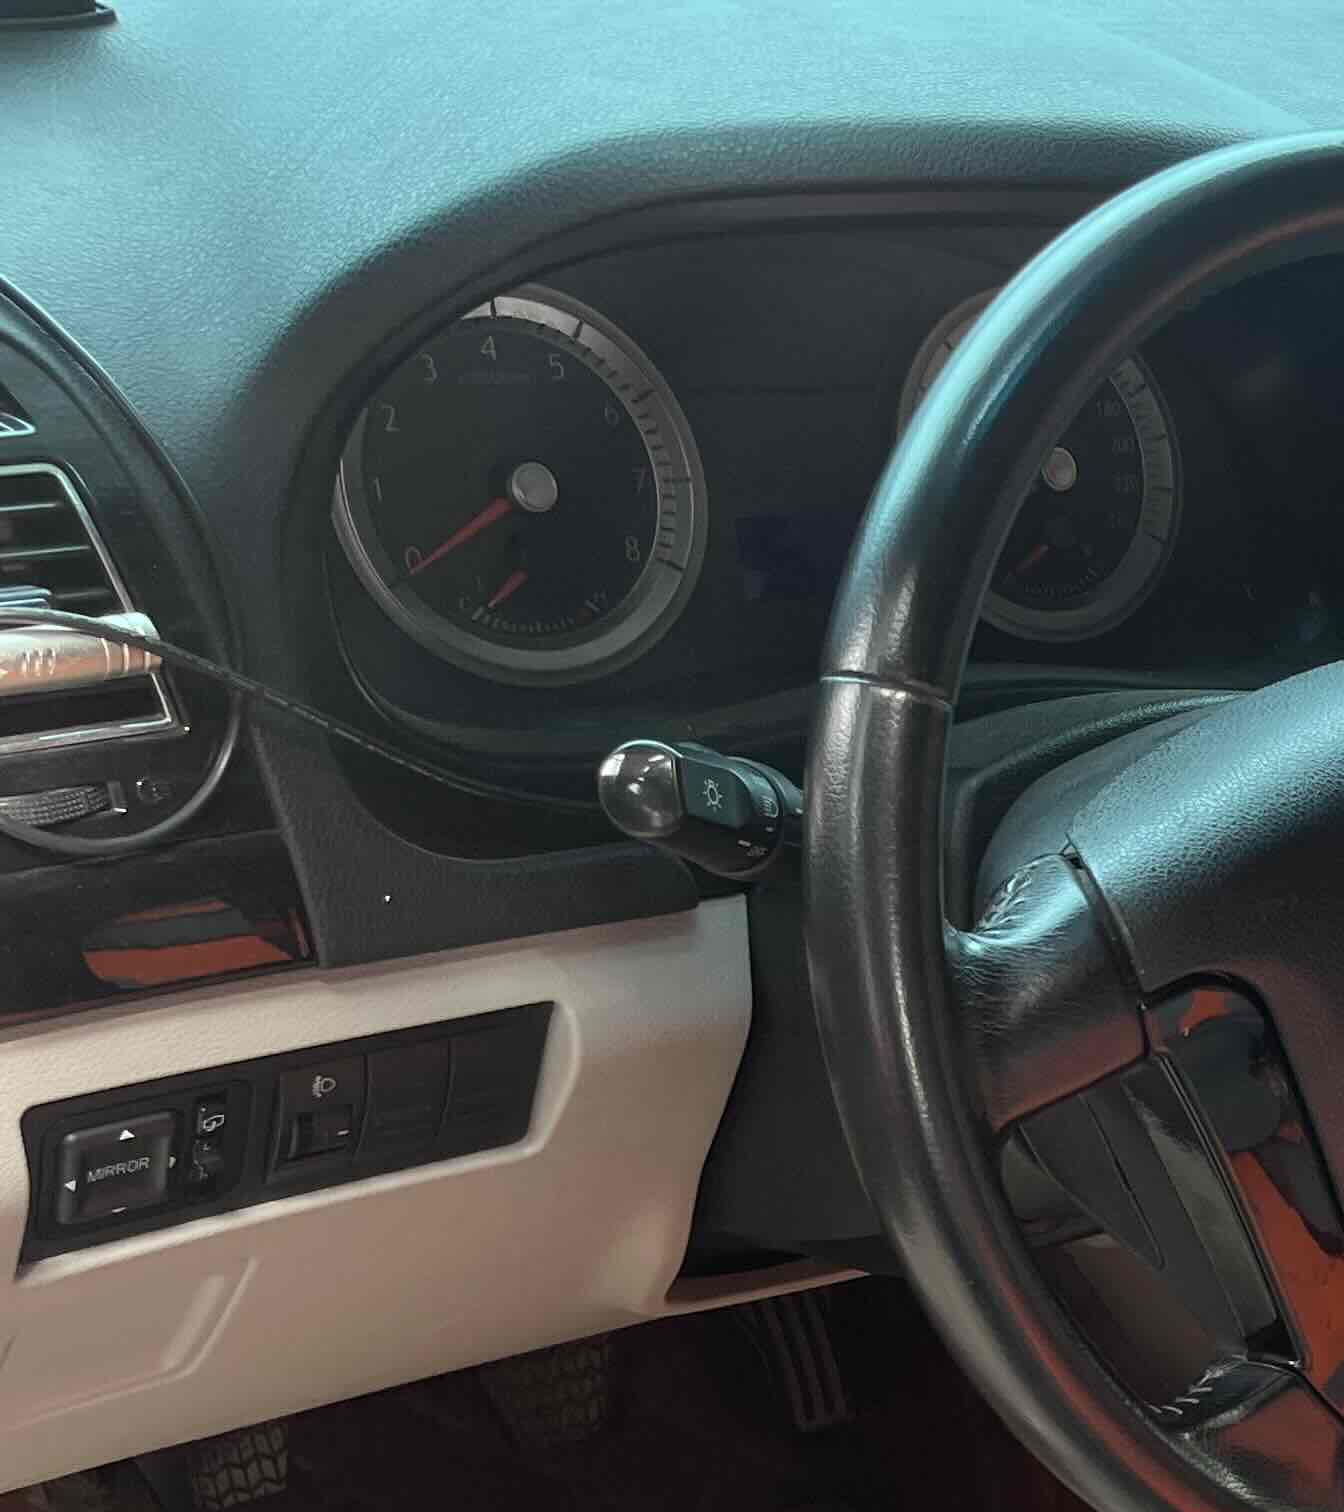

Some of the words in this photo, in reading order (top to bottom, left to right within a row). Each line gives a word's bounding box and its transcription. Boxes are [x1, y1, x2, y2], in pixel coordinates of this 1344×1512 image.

[479, 335, 497, 361] 4
[418, 352, 439, 384] 3
[547, 353, 567, 381] 5
[378, 404, 401, 432] 2
[603, 403, 621, 427] 6
[371, 476, 384, 502] 1
[633, 466, 652, 494] 7
[623, 536, 641, 561] 8
[87, 1157, 151, 1183] MIRROR
